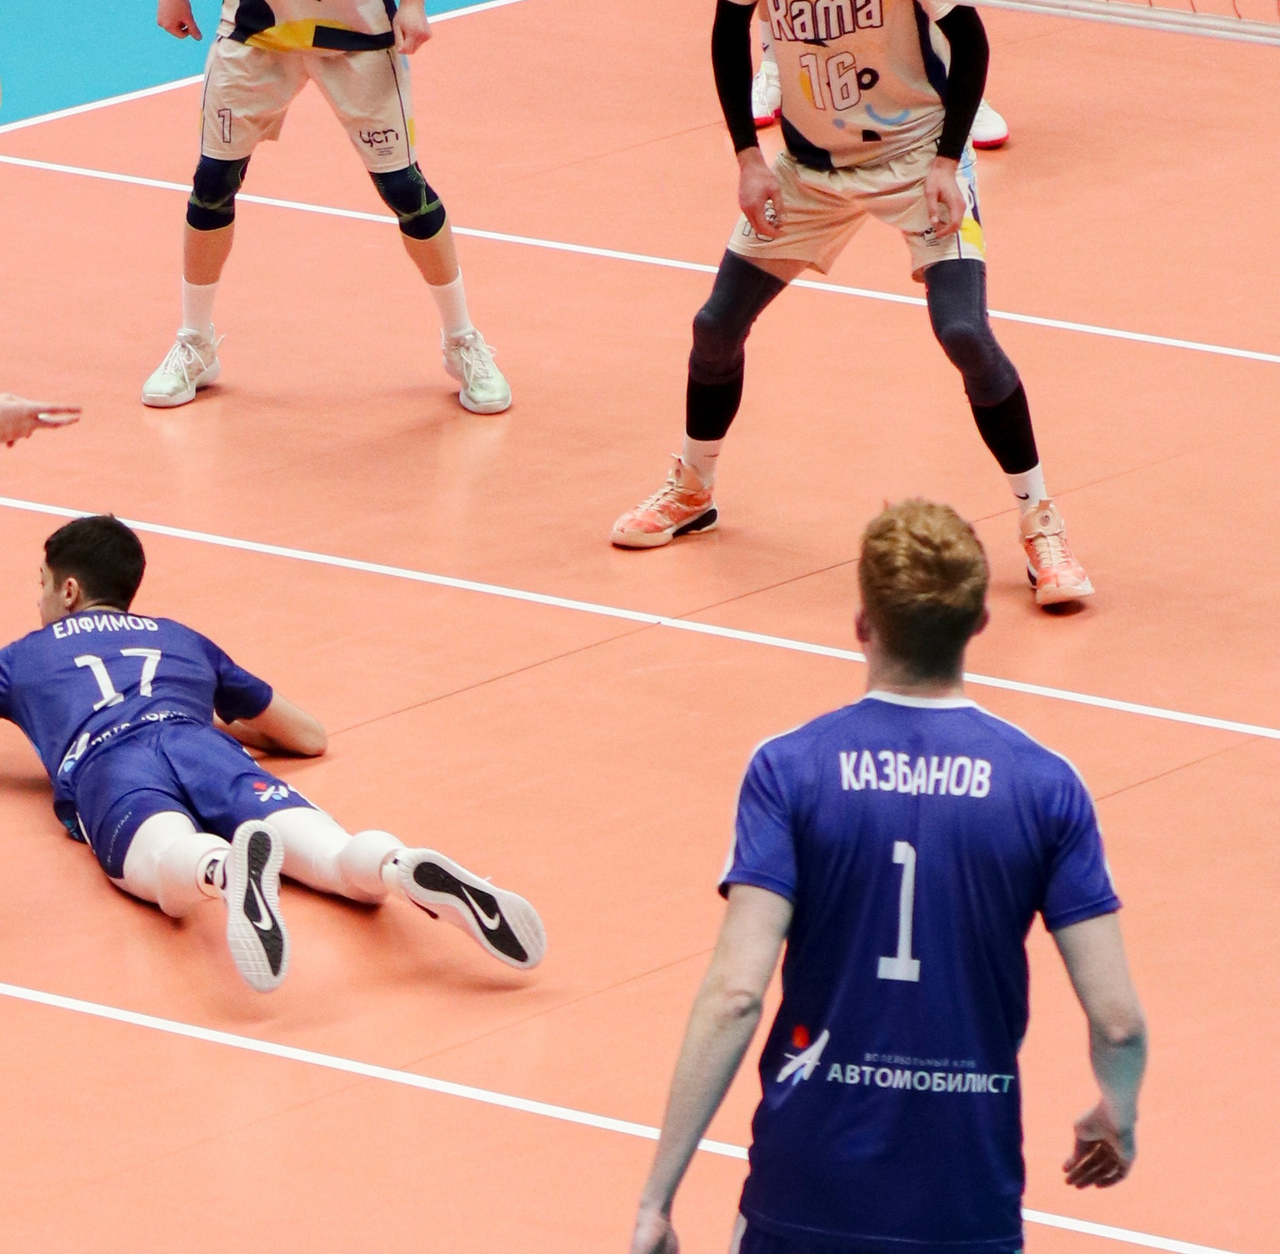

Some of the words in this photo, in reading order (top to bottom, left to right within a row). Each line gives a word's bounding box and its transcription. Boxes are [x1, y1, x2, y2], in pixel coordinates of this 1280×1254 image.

[799, 50, 861, 112] 16
[218, 108, 232, 143] 1
[52, 614, 159, 639] ЕЛФИМОВ
[73, 648, 162, 712] 17
[839, 750, 992, 799] КАЗБАНОВ
[877, 840, 921, 982] 1
[827, 1063, 1015, 1094] АВТОМОБИЛИСТ
